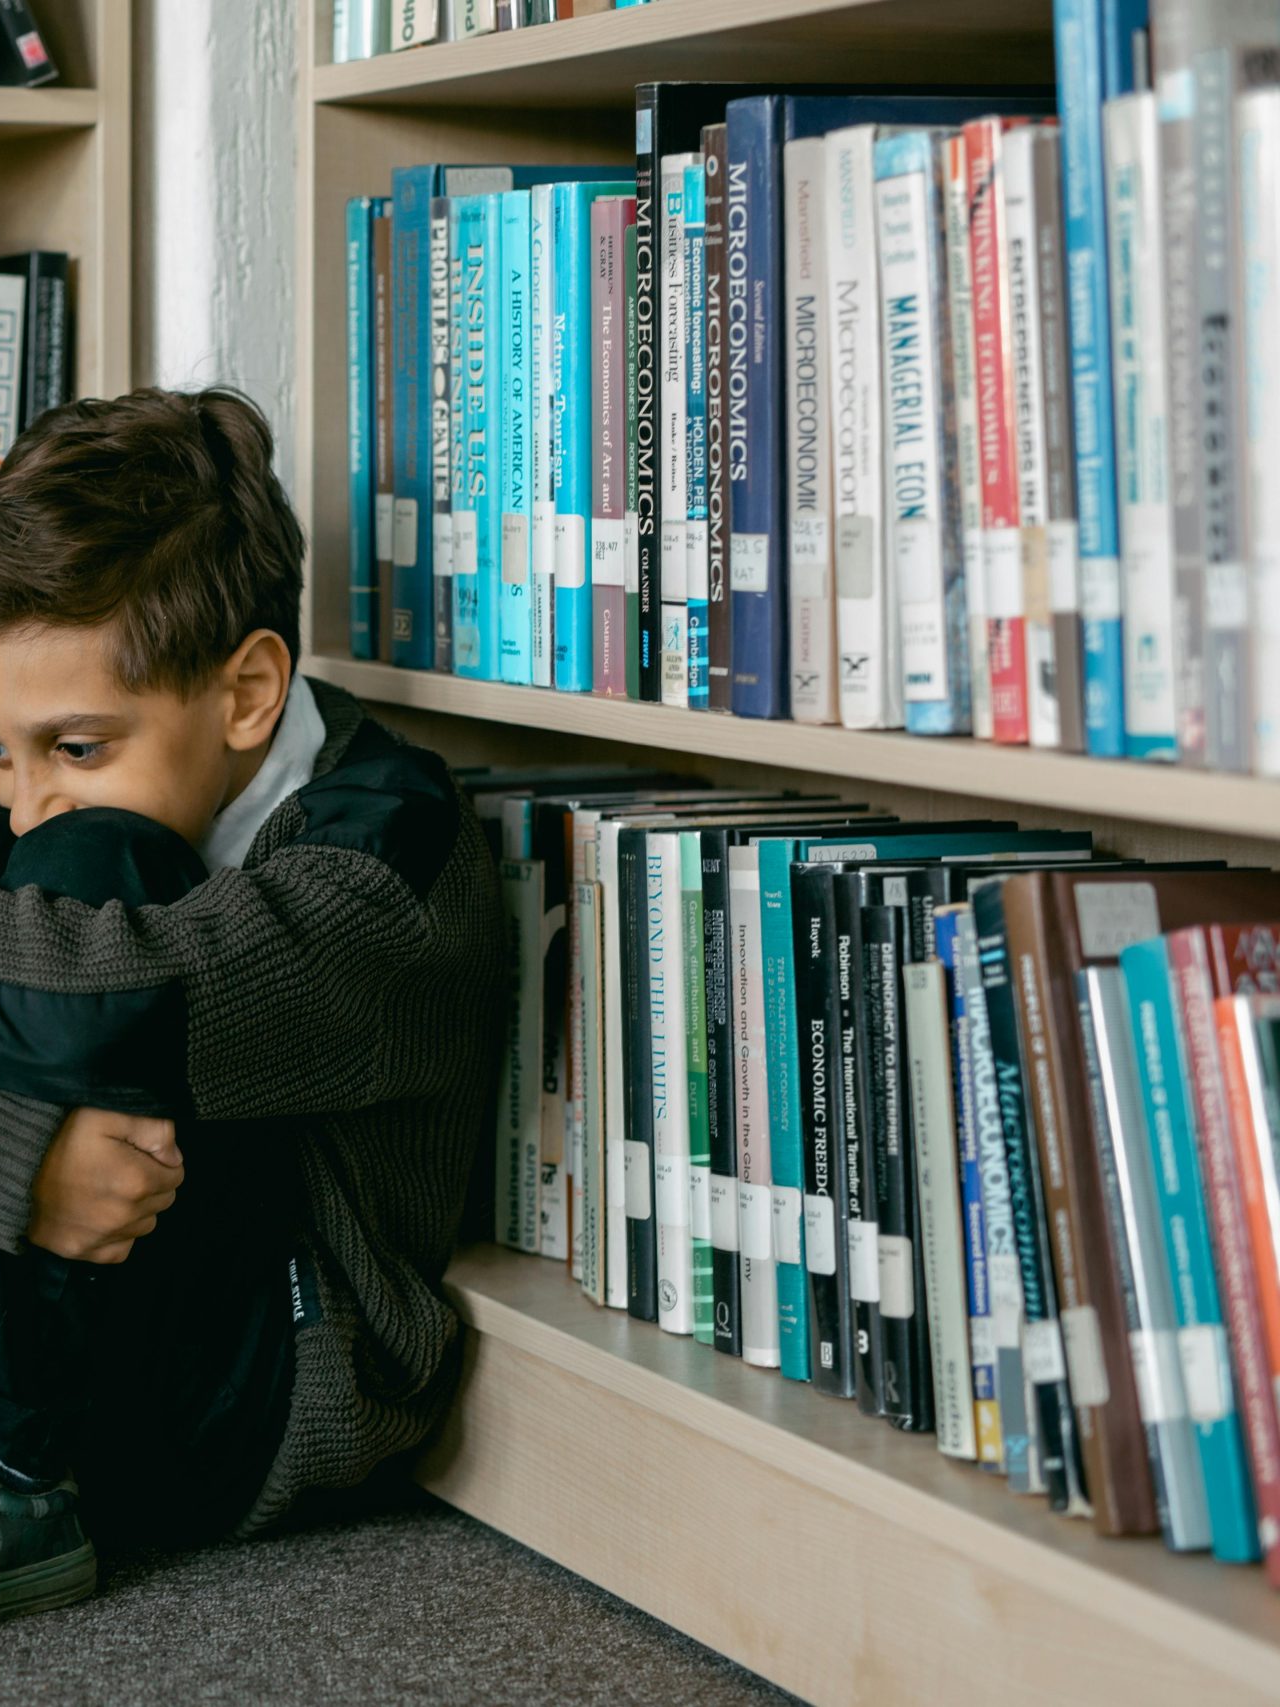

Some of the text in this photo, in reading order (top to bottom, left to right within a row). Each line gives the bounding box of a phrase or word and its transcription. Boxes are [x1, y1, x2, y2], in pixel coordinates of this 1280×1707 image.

[796, 179, 811, 280] Mansfield
[838, 150, 856, 249] MANSFIELD
[430, 217, 450, 365] PROFILES
[599, 249, 607, 280] GRAY
[665, 192, 683, 383] Business Forecasting
[690, 237, 703, 395] Economic forecasting:
[467, 244, 487, 506] INSIDE U.S.
[636, 197, 654, 536] MICROECONOMICS
[728, 162, 748, 481] MICROECONOMICS
[753, 279, 765, 363] Second Edition
[887, 293, 926, 452] MANAGERIAL
[1010, 237, 1037, 472] ENTREPRENEURS
[511, 269, 524, 509] A HISTORY OF AMERICAN
[553, 314, 568, 488] Nature Tourism
[601, 302, 613, 514] The Economics of Art and
[627, 296, 635, 513] AMERICA'S BUSINESS ROBERTSON
[706, 274, 724, 602] MICROECONOMICS
[691, 416, 704, 481] HOLDEN,
[641, 547, 650, 614] COLANDER
[800, 607, 811, 663] EDITION
[602, 609, 610, 676] CAMBRIDGE
[641, 629, 649, 668] IRWIN
[689, 616, 699, 688] Cambridge
[647, 855, 667, 1120] BEYOND THE LIMITS
[688, 900, 701, 1063] Growth, distribution, and
[711, 909, 725, 1025] ENTREPRENEURSHIP
[810, 916, 821, 959] Hayek
[881, 943, 896, 1041] DEPENDENCY
[738, 924, 751, 1148] Innovation and Growth in the
[810, 1019, 826, 1123] ECONOMIC
[838, 935, 861, 1213] Robinson The International Transfer of
[885, 1043, 896, 1067] TO
[689, 1081, 698, 1119] DUTT
[708, 1058, 718, 1138] GOVERNMENT
[885, 1067, 899, 1155] ENTERPRISE
[523, 1143, 537, 1249] structure
[291, 1284, 305, 1323] STYLE
[969, 1202, 987, 1315] Second Edition
